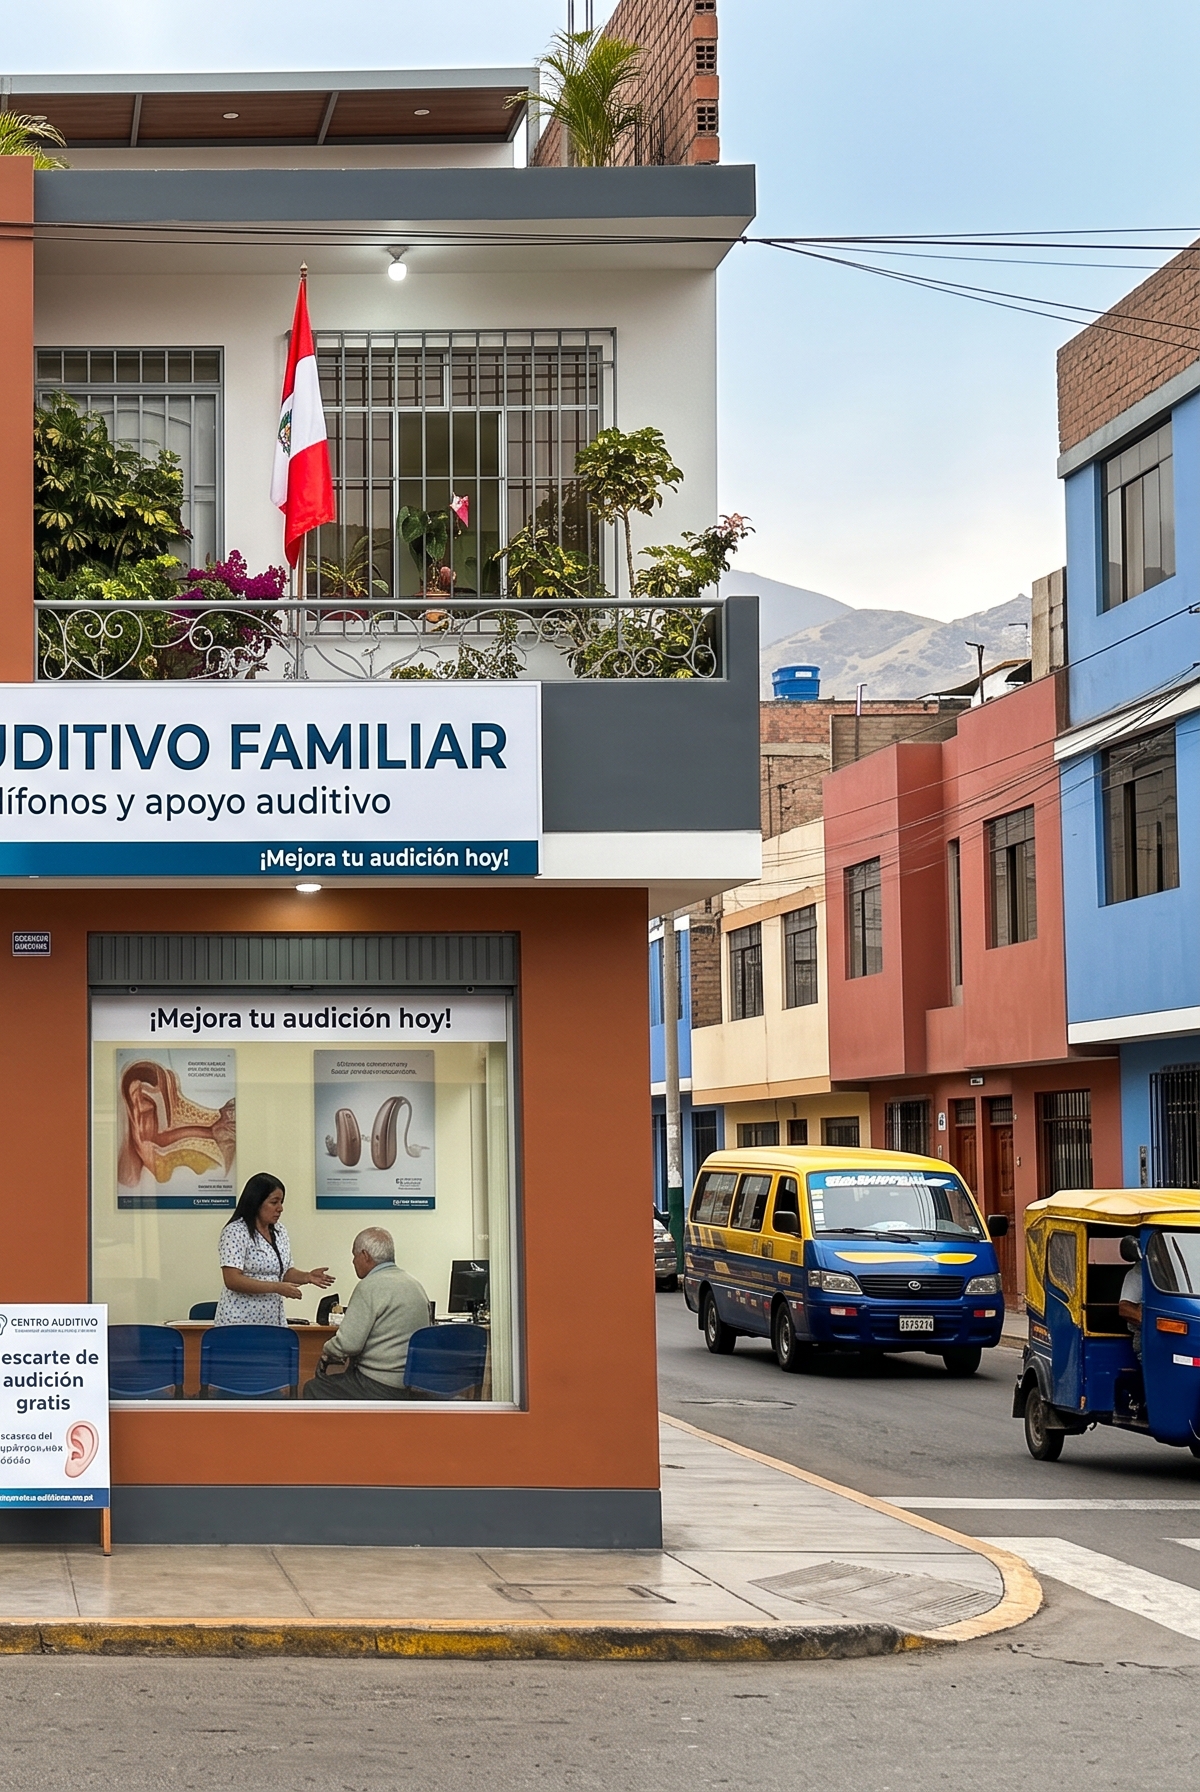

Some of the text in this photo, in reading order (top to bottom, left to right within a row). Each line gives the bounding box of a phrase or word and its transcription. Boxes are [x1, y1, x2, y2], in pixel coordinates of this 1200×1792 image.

[230, 722, 507, 770] FAMILIAR
[117, 793, 136, 822] y
[145, 793, 246, 822] apoyo
[256, 785, 391, 815] auditivo
[260, 847, 509, 872] ¡Mejora tu audición hoy!
[149, 1006, 452, 1034] ¡Mejora tu audición hoy!
[11, 1317, 98, 1327] CENTRO AUDITIVO
[75, 1348, 99, 1365] de
[3, 1371, 84, 1388] audición
[16, 1394, 71, 1414] gratis
